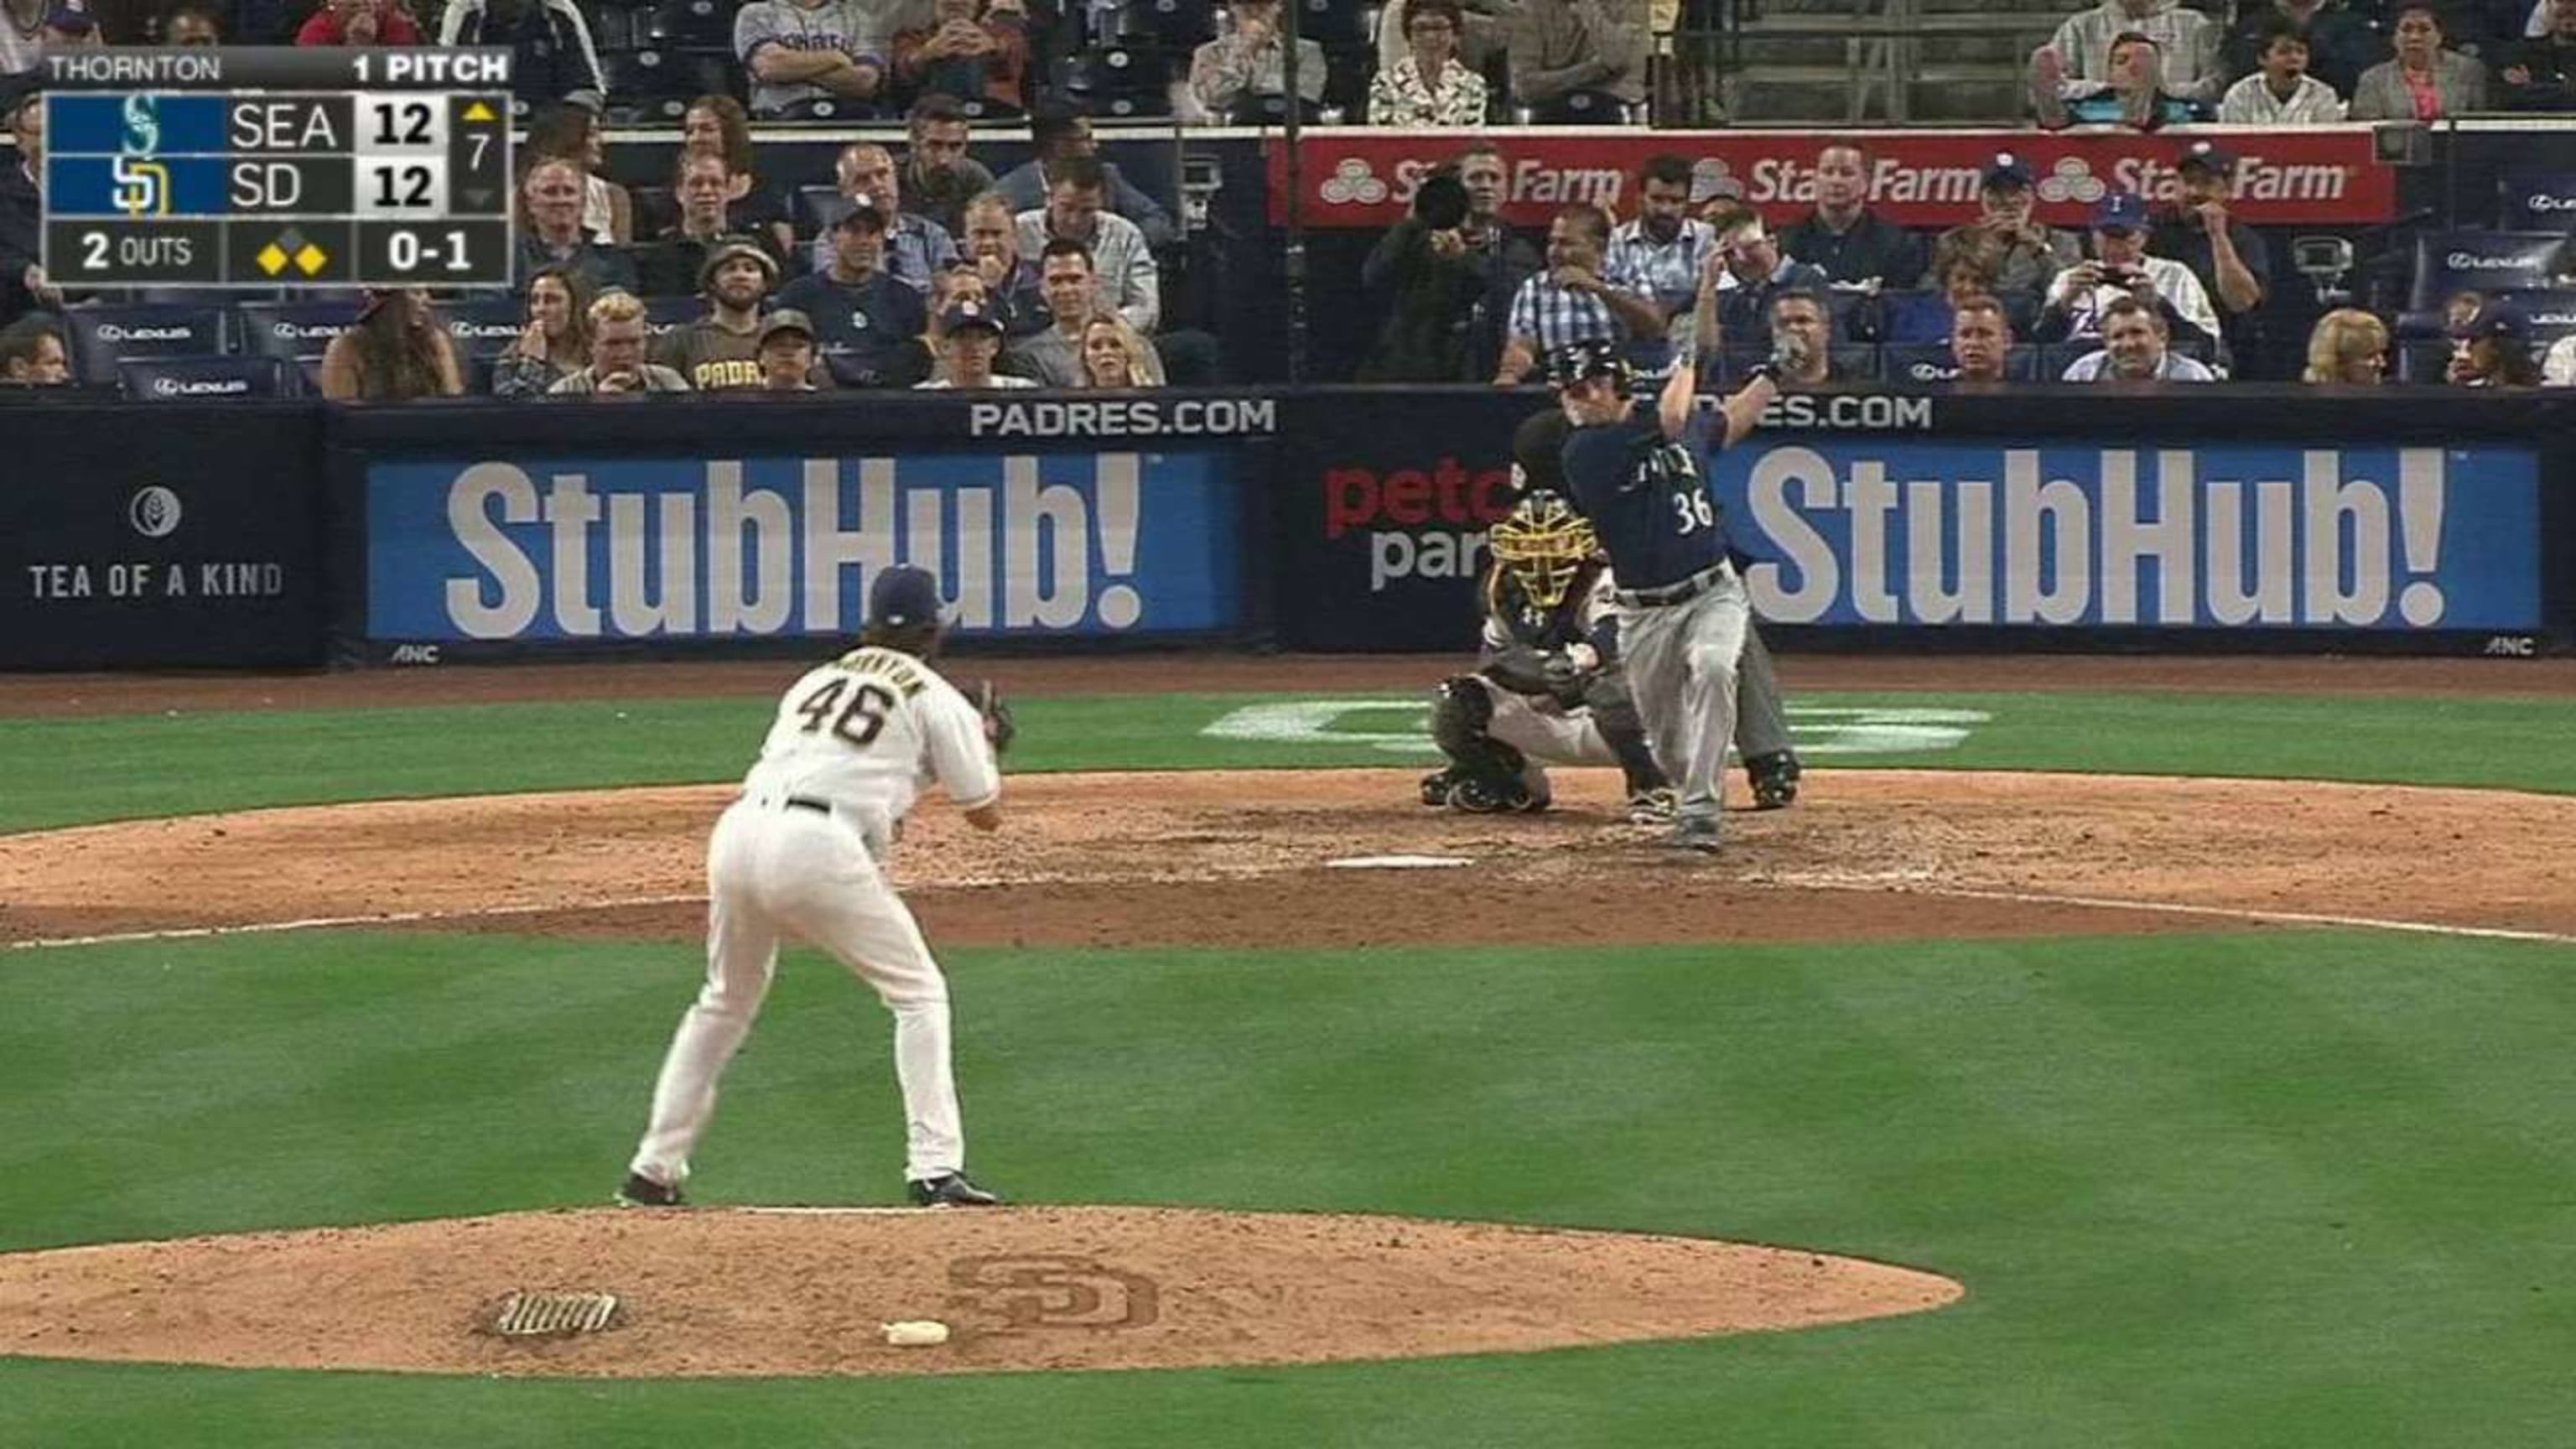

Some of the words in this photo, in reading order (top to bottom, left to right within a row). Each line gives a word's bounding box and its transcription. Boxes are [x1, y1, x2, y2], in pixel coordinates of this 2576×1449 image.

[1511, 160, 1623, 203] Farm
[1749, 160, 1815, 202] Sta
[1868, 159, 1981, 202] Farm
[2114, 158, 2180, 200] Sta
[2231, 158, 2345, 200] Farm
[298, 327, 352, 337] LEXU
[694, 360, 764, 391] PADR
[970, 400, 1275, 436] PADRES.COM
[1322, 457, 1512, 538] petc
[1674, 489, 1713, 535] 36
[446, 453, 1142, 640] StubHub!
[1748, 445, 2444, 626] StubHub!
[28, 565, 91, 598] TEA
[108, 564, 151, 596] OF
[167, 564, 186, 596] A
[201, 563, 282, 596] KIND
[1371, 531, 1488, 591] par
[797, 677, 895, 745] 46
